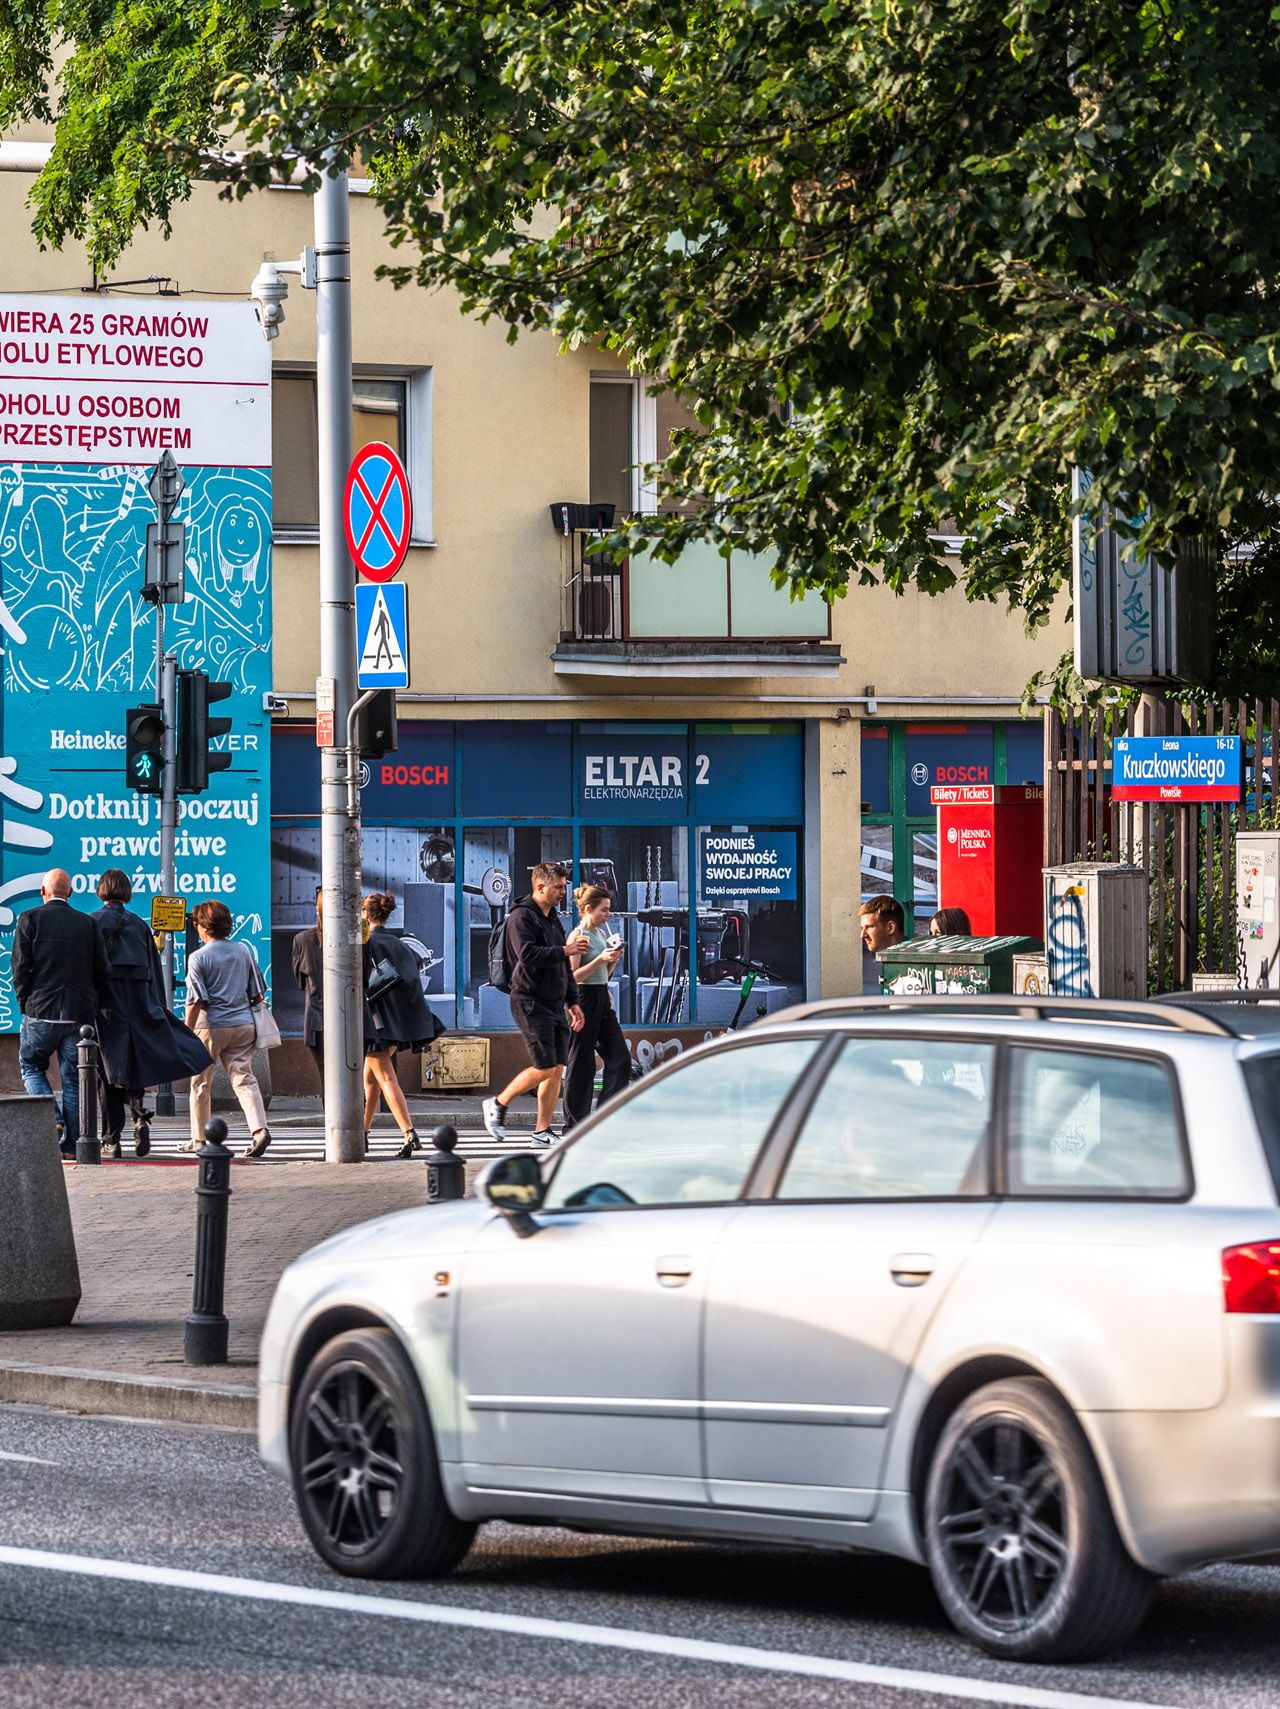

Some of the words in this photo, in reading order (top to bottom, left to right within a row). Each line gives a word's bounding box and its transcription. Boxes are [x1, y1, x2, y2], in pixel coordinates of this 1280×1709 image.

[69, 312, 95, 335] 25
[101, 311, 209, 338] GRAMÓW
[57, 343, 204, 368] ETYLOWEGO
[78, 395, 181, 418] OSOBOM
[50, 729, 127, 750] Heineke
[1117, 740, 1128, 751] ulica
[1162, 740, 1179, 750] Leona
[1216, 738, 1235, 750] 16-12
[381, 765, 449, 785] BOSCH
[585, 756, 683, 786] ELTAR
[695, 754, 710, 785] 2
[936, 766, 988, 783] BOSCH
[1123, 752, 1226, 785] Kruczkowskiego
[584, 787, 684, 801] ELEKTRONARZĘDZIA
[962, 787, 989, 799] Tickets
[1025, 788, 1044, 799] Bile
[1160, 786, 1182, 797] Powiśle
[48, 793, 150, 826] Dotknij
[706, 834, 755, 850] PODNIEŚ
[961, 829, 991, 839] MENNICA
[961, 839, 986, 849] POLSKA
[706, 849, 778, 865] WYDAJNOŚĆ
[706, 867, 753, 879] SWOJEJ
[754, 867, 792, 879] PRACY
[705, 886, 726, 895] Dzięki
[726, 886, 760, 895] osprzętowi
[761, 886, 780, 894] Bosch
